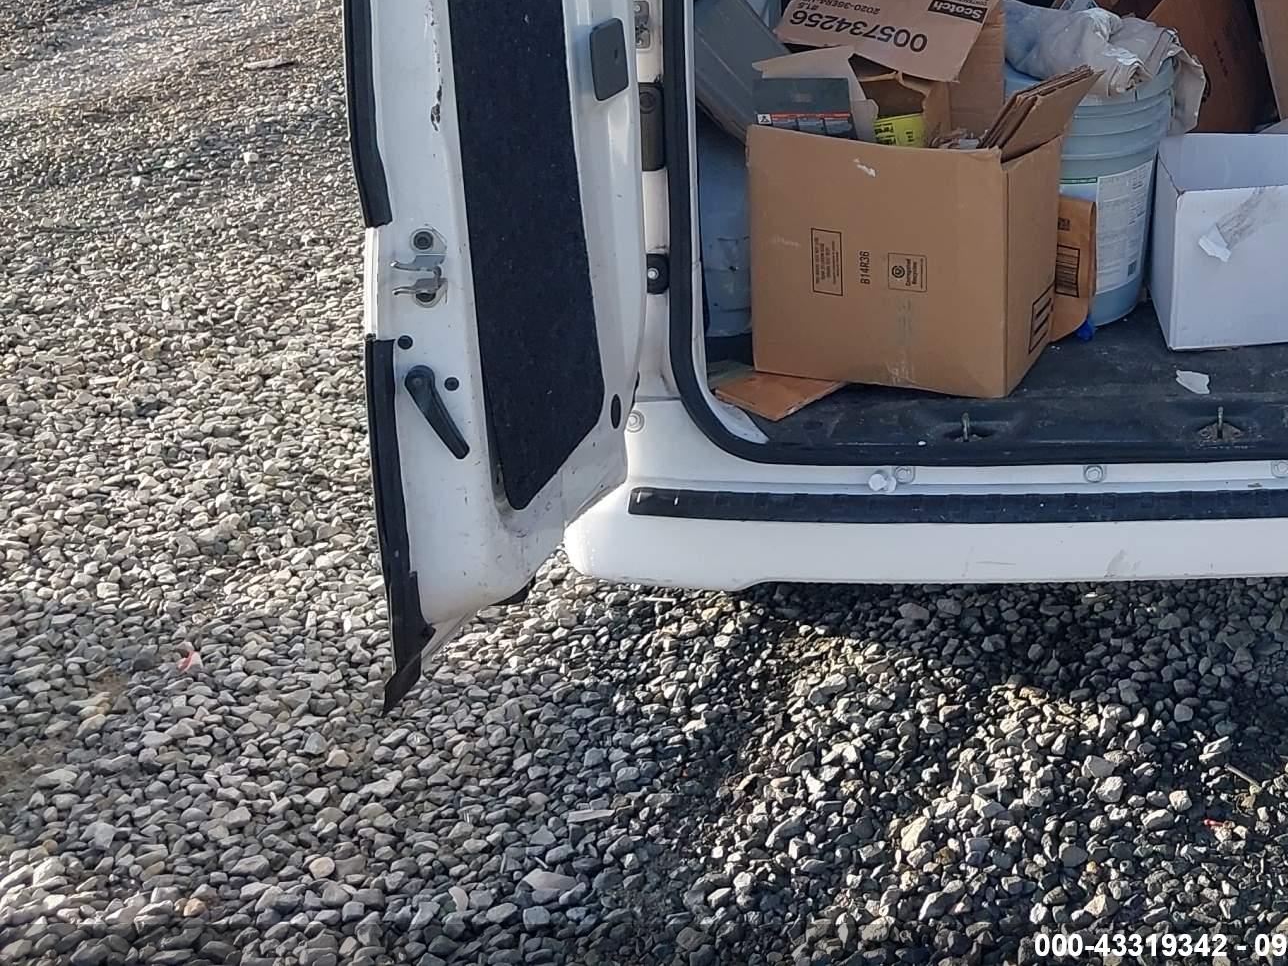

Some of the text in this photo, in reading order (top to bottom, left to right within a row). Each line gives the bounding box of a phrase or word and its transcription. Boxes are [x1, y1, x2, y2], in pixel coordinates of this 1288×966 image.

[932, 0, 983, 20] Scotch
[788, 10, 928, 53] 005734256
[859, 250, 872, 285] B14R36
